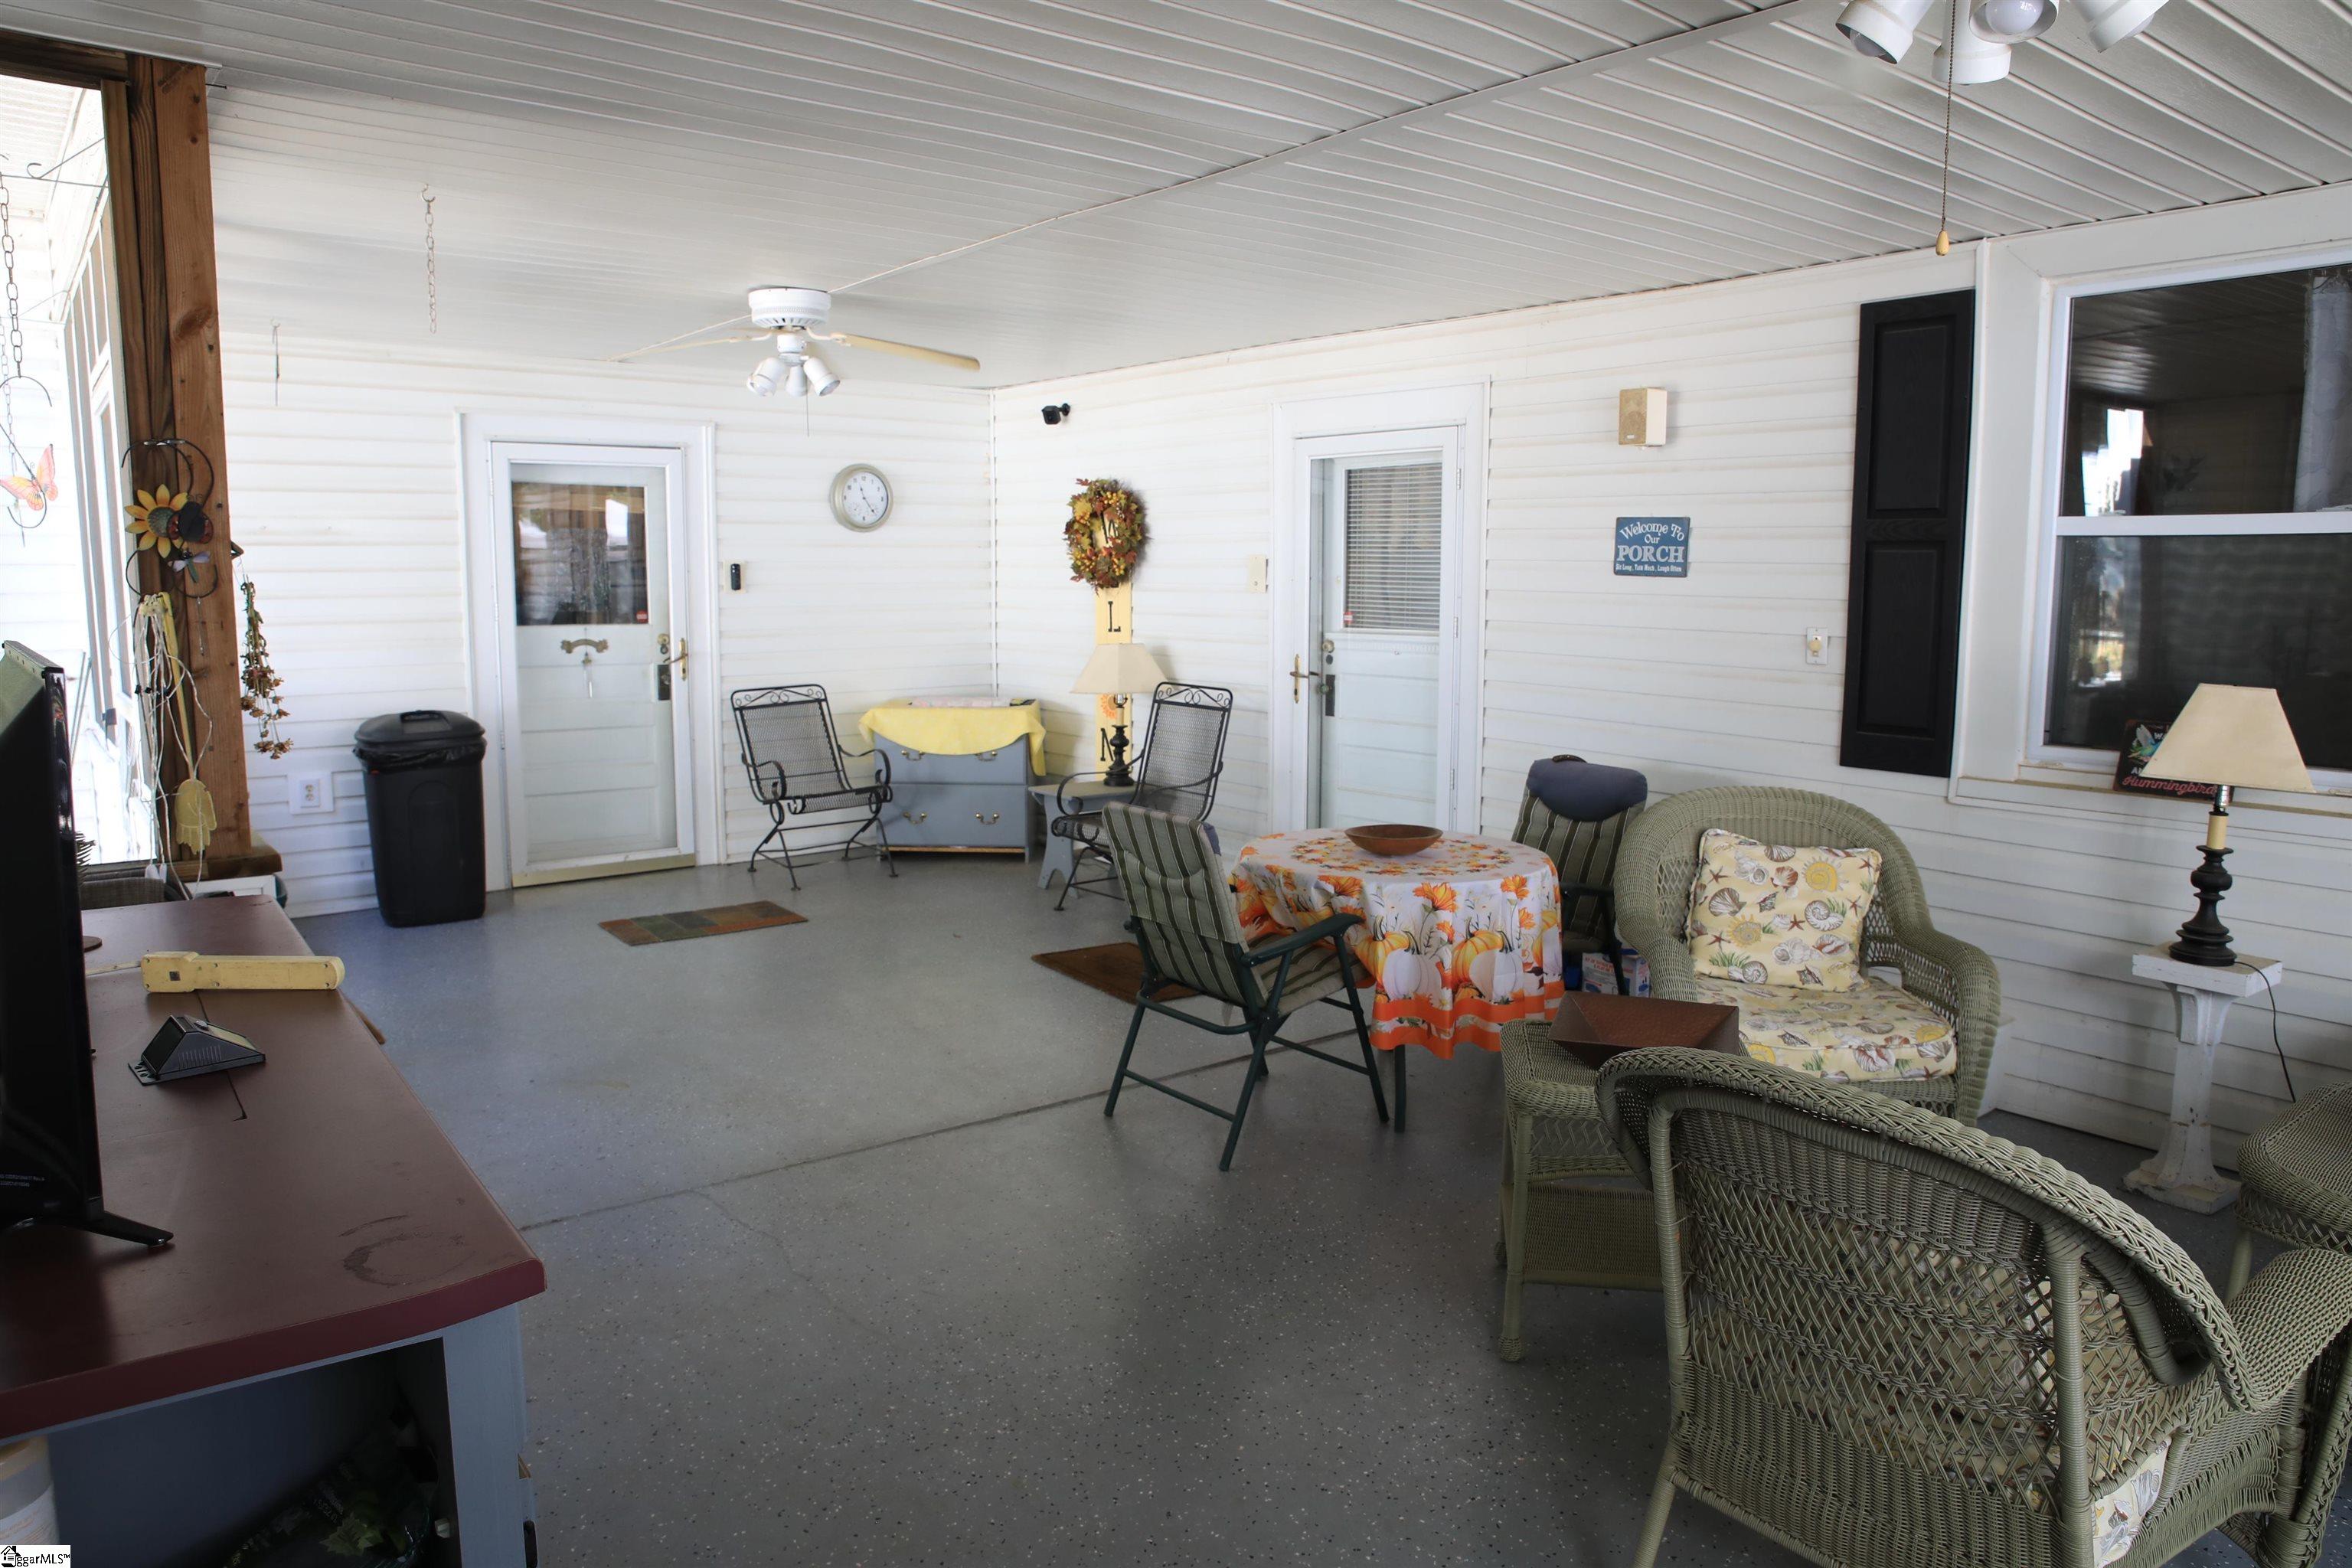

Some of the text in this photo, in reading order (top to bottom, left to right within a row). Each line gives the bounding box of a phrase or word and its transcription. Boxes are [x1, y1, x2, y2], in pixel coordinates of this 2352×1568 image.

[1619, 521, 1684, 541] Welcome To
[1645, 534, 1660, 544] Our
[1616, 545, 1684, 563] PORCH
